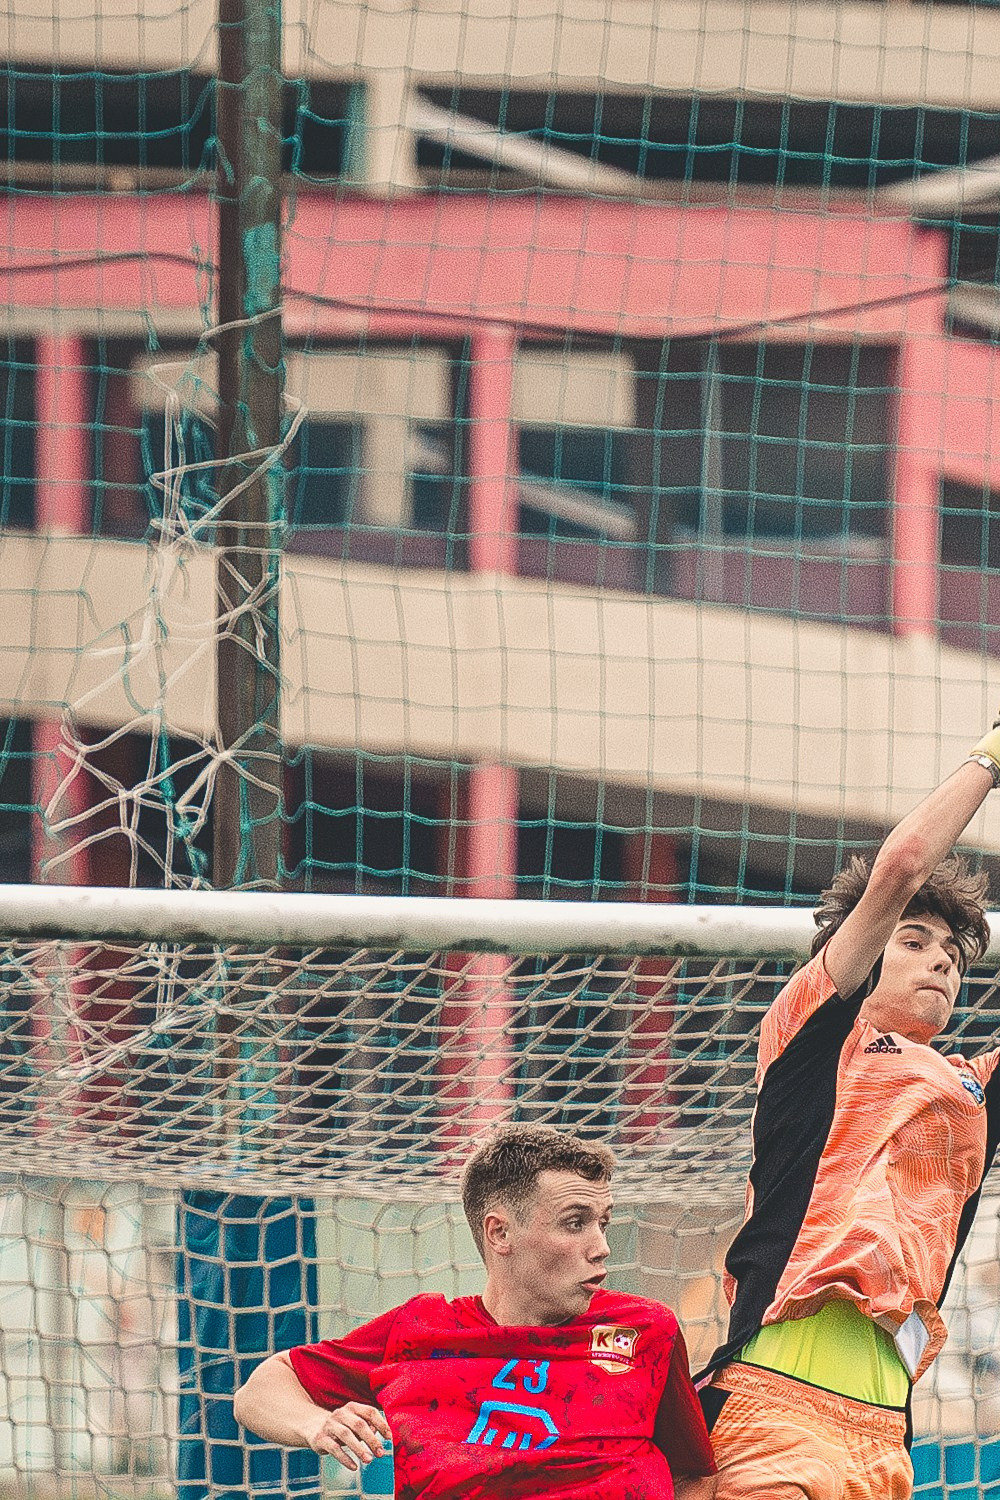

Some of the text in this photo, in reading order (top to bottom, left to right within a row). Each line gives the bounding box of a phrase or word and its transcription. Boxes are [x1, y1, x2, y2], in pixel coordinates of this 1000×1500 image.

[864, 1045, 902, 1054] adidas
[597, 1332, 611, 1348] K
[492, 1358, 550, 1394] 23
